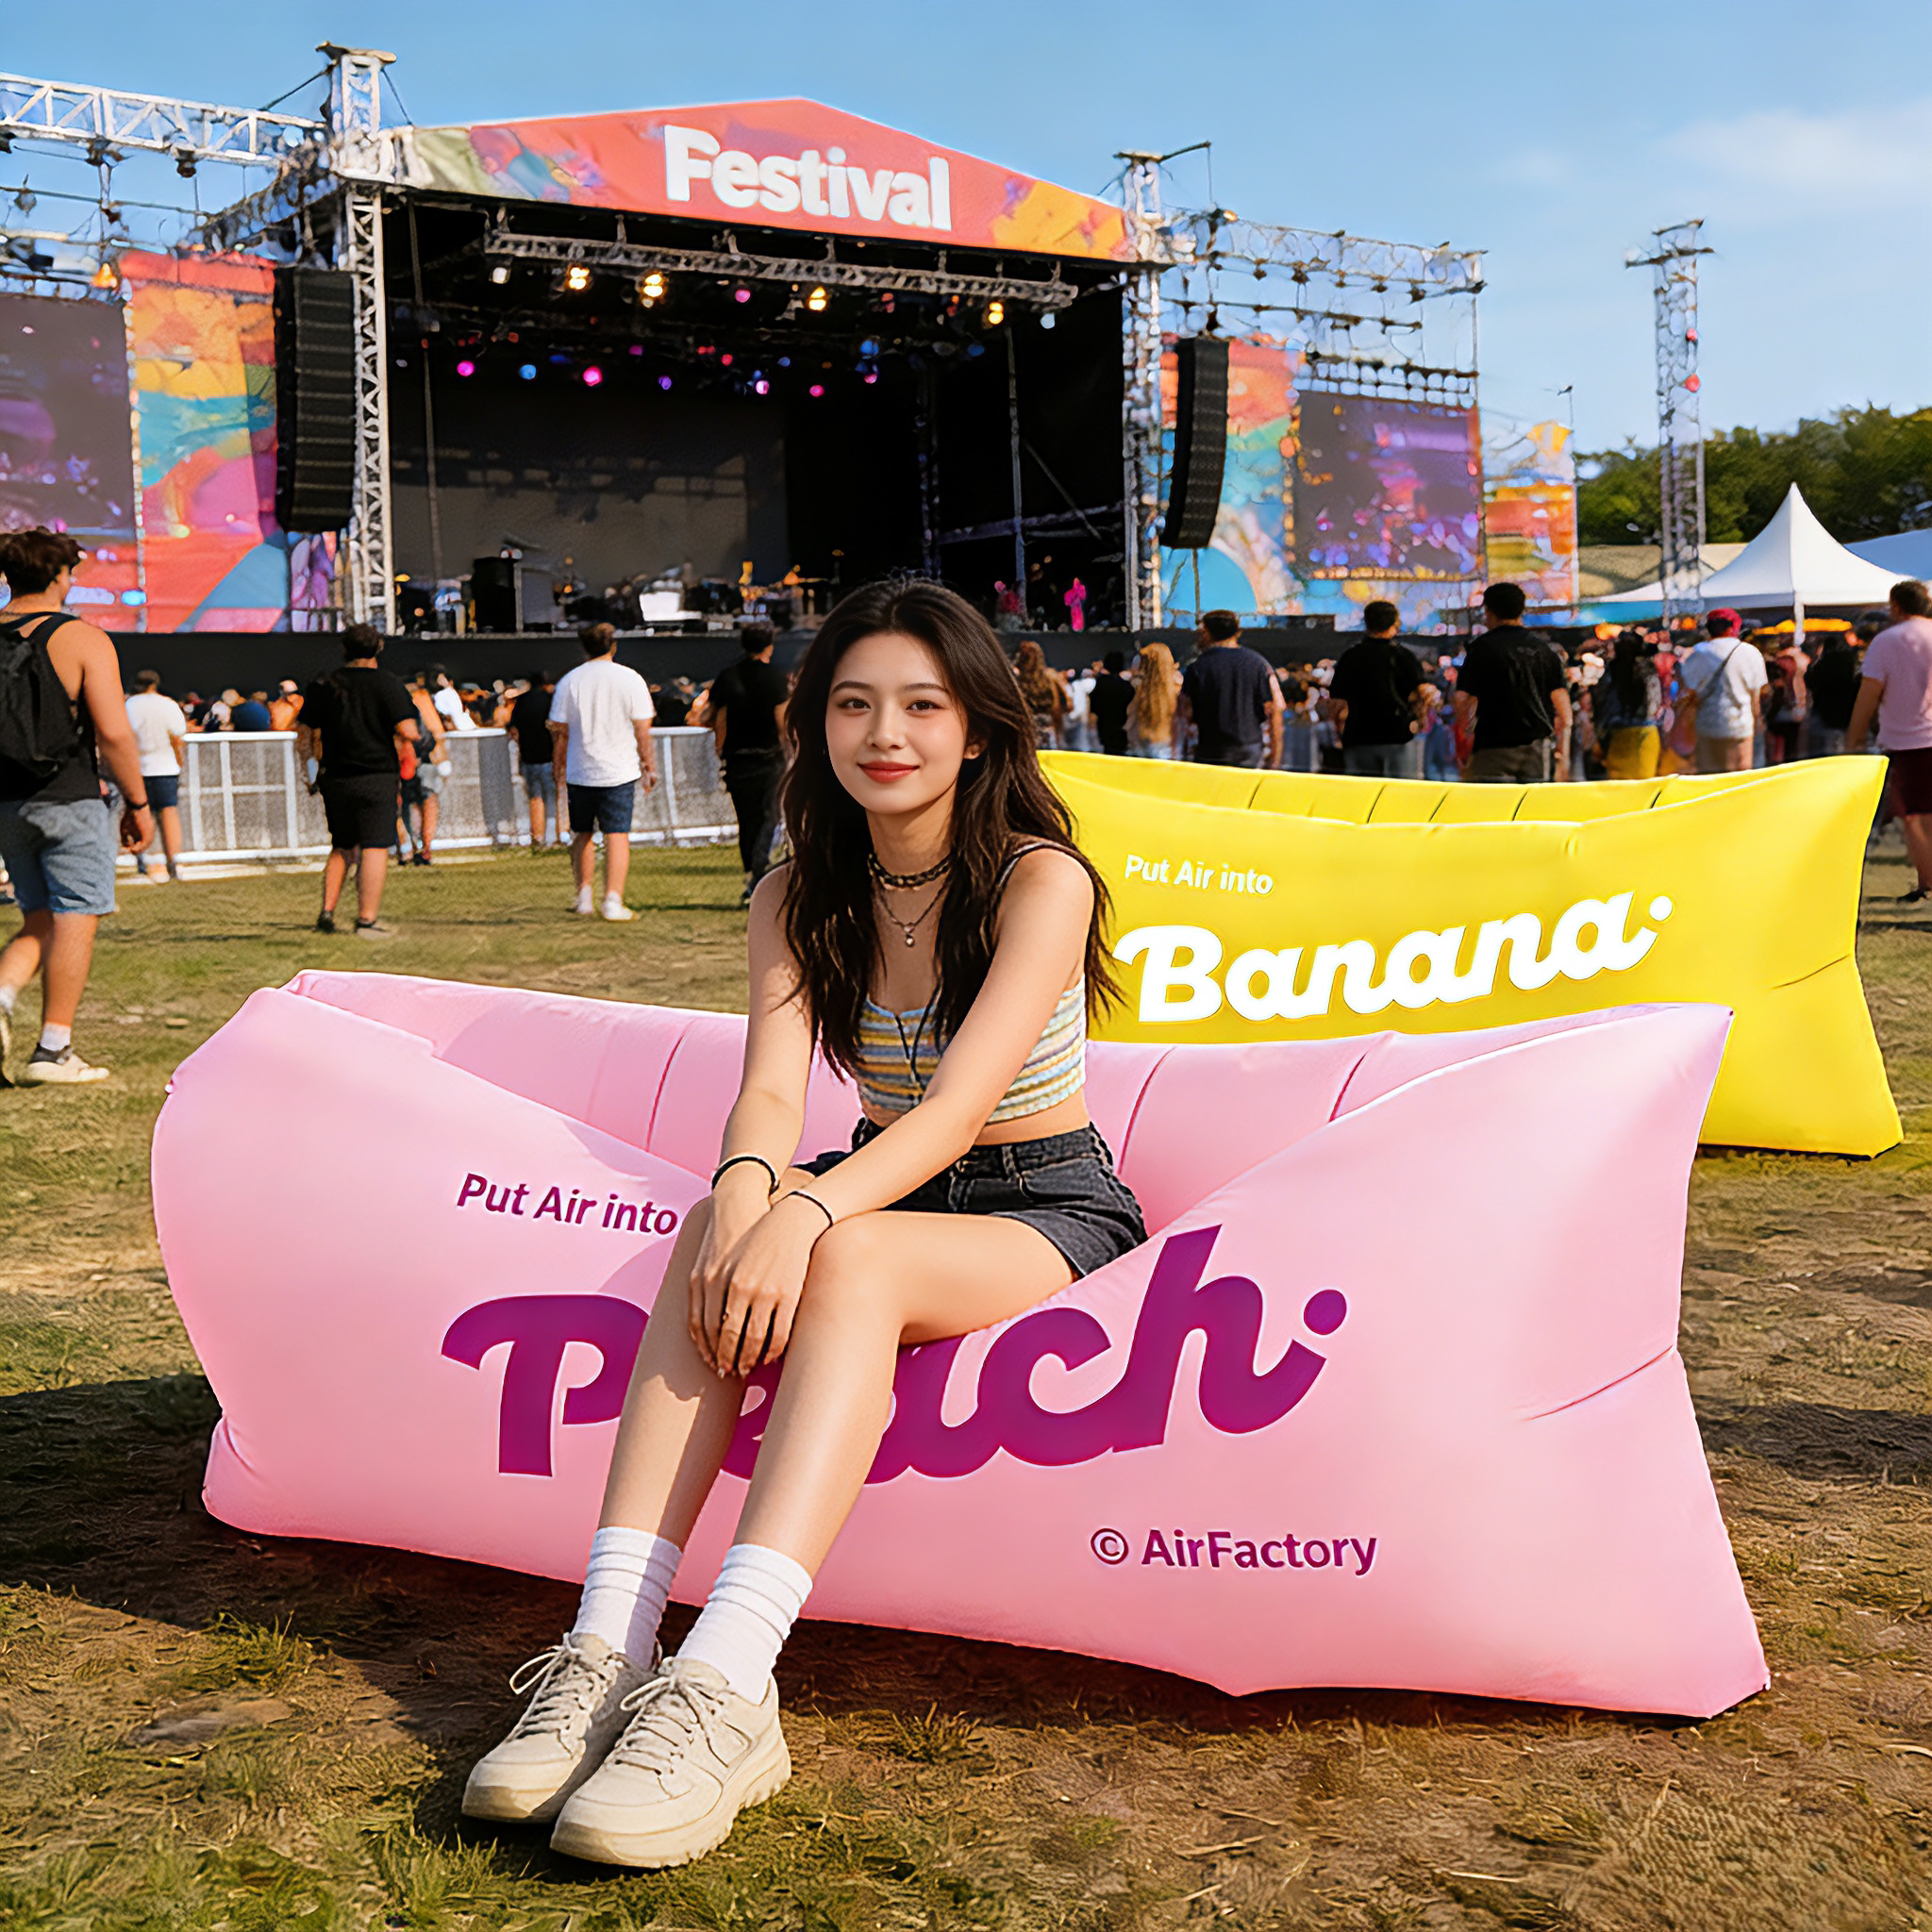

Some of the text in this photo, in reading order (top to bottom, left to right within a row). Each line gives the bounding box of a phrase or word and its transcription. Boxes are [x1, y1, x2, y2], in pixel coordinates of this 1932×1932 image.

[663, 124, 952, 231] Festival
[1124, 854, 1274, 895] Put Air into
[457, 1173, 679, 1236] Put Air into
[1141, 1528, 1378, 1576] AirFactory
